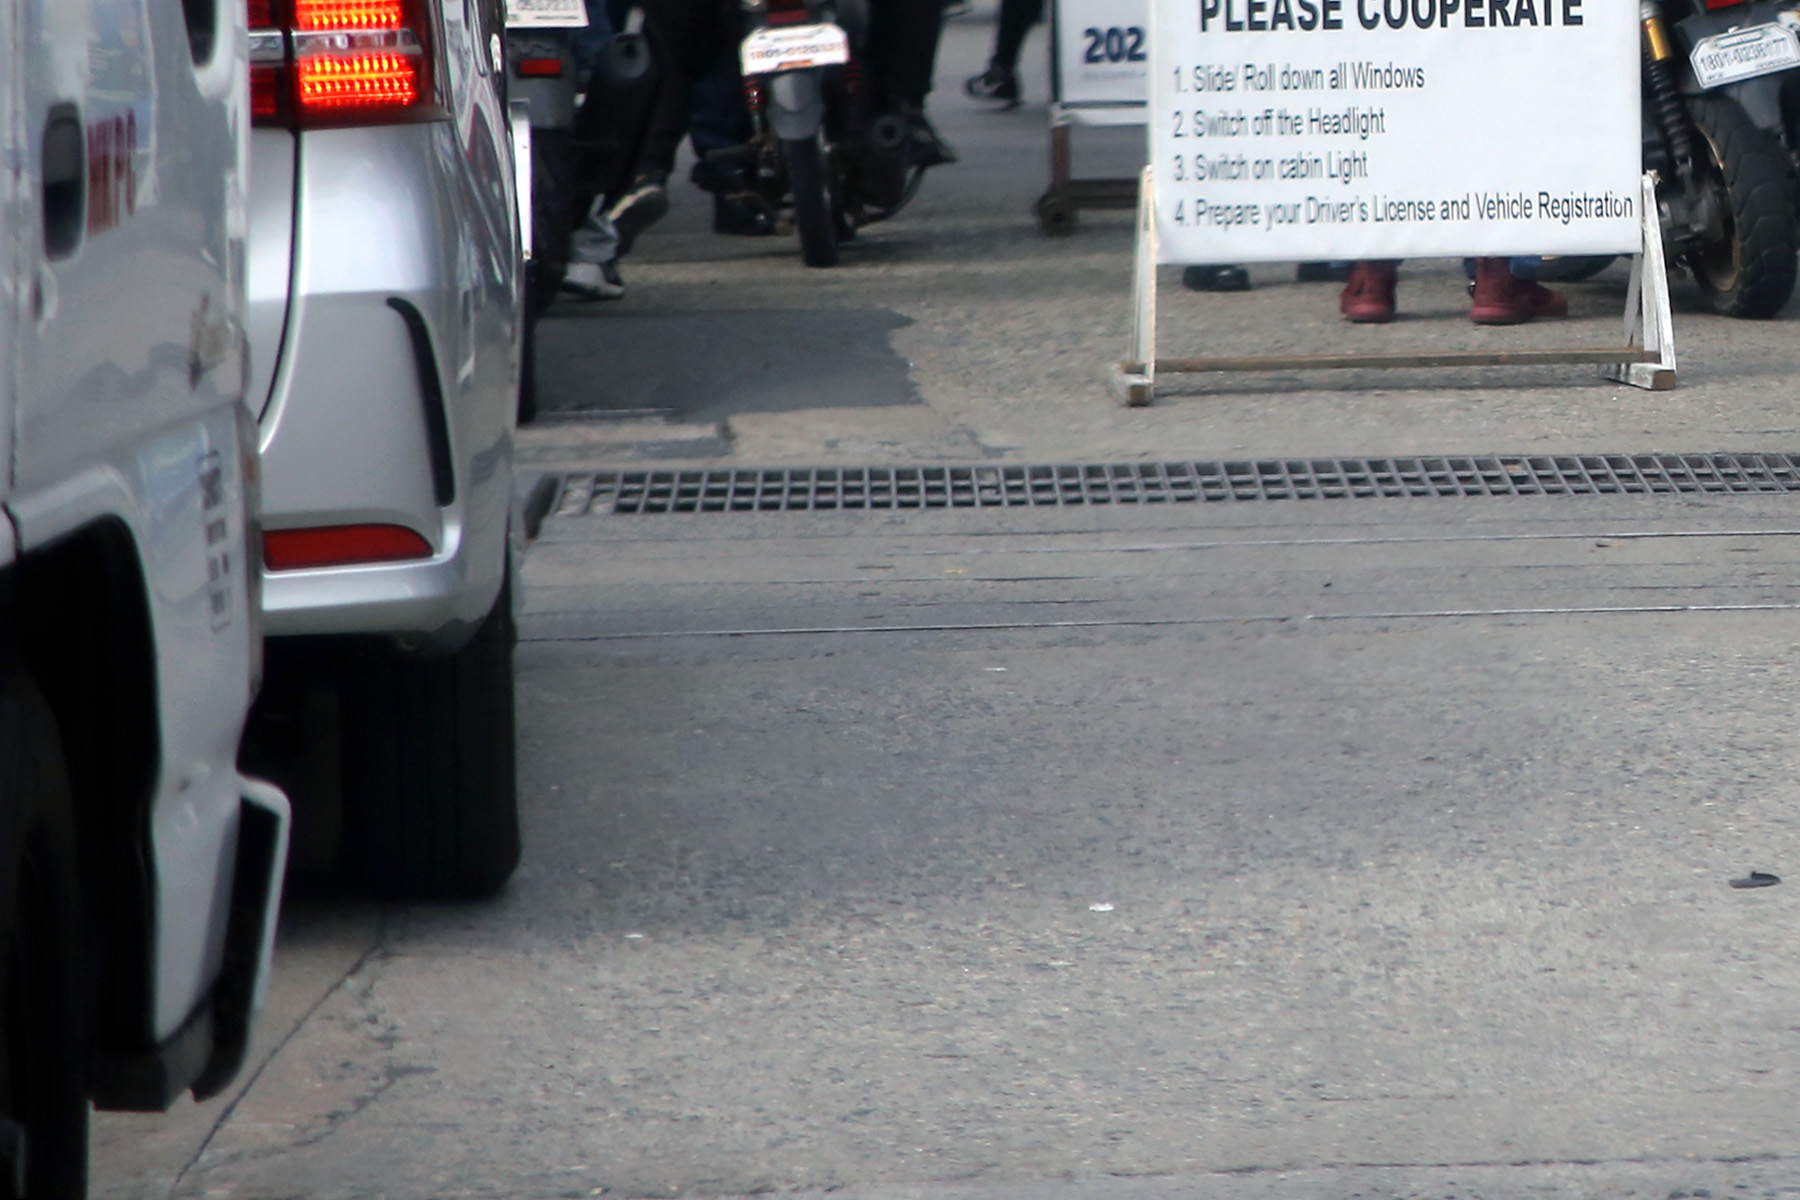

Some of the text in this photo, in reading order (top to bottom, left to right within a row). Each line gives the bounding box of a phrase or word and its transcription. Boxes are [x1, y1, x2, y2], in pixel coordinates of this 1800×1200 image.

[1174, 61, 1425, 92] 1. Slide/ Roll down all Windows
[1174, 107, 1385, 140] 2. Switch off the Headlight
[1174, 150, 1368, 184] 3. Switch on cabin Light
[1175, 191, 1632, 231] 4. Prepare your Driver's License and Vehicle Registration
